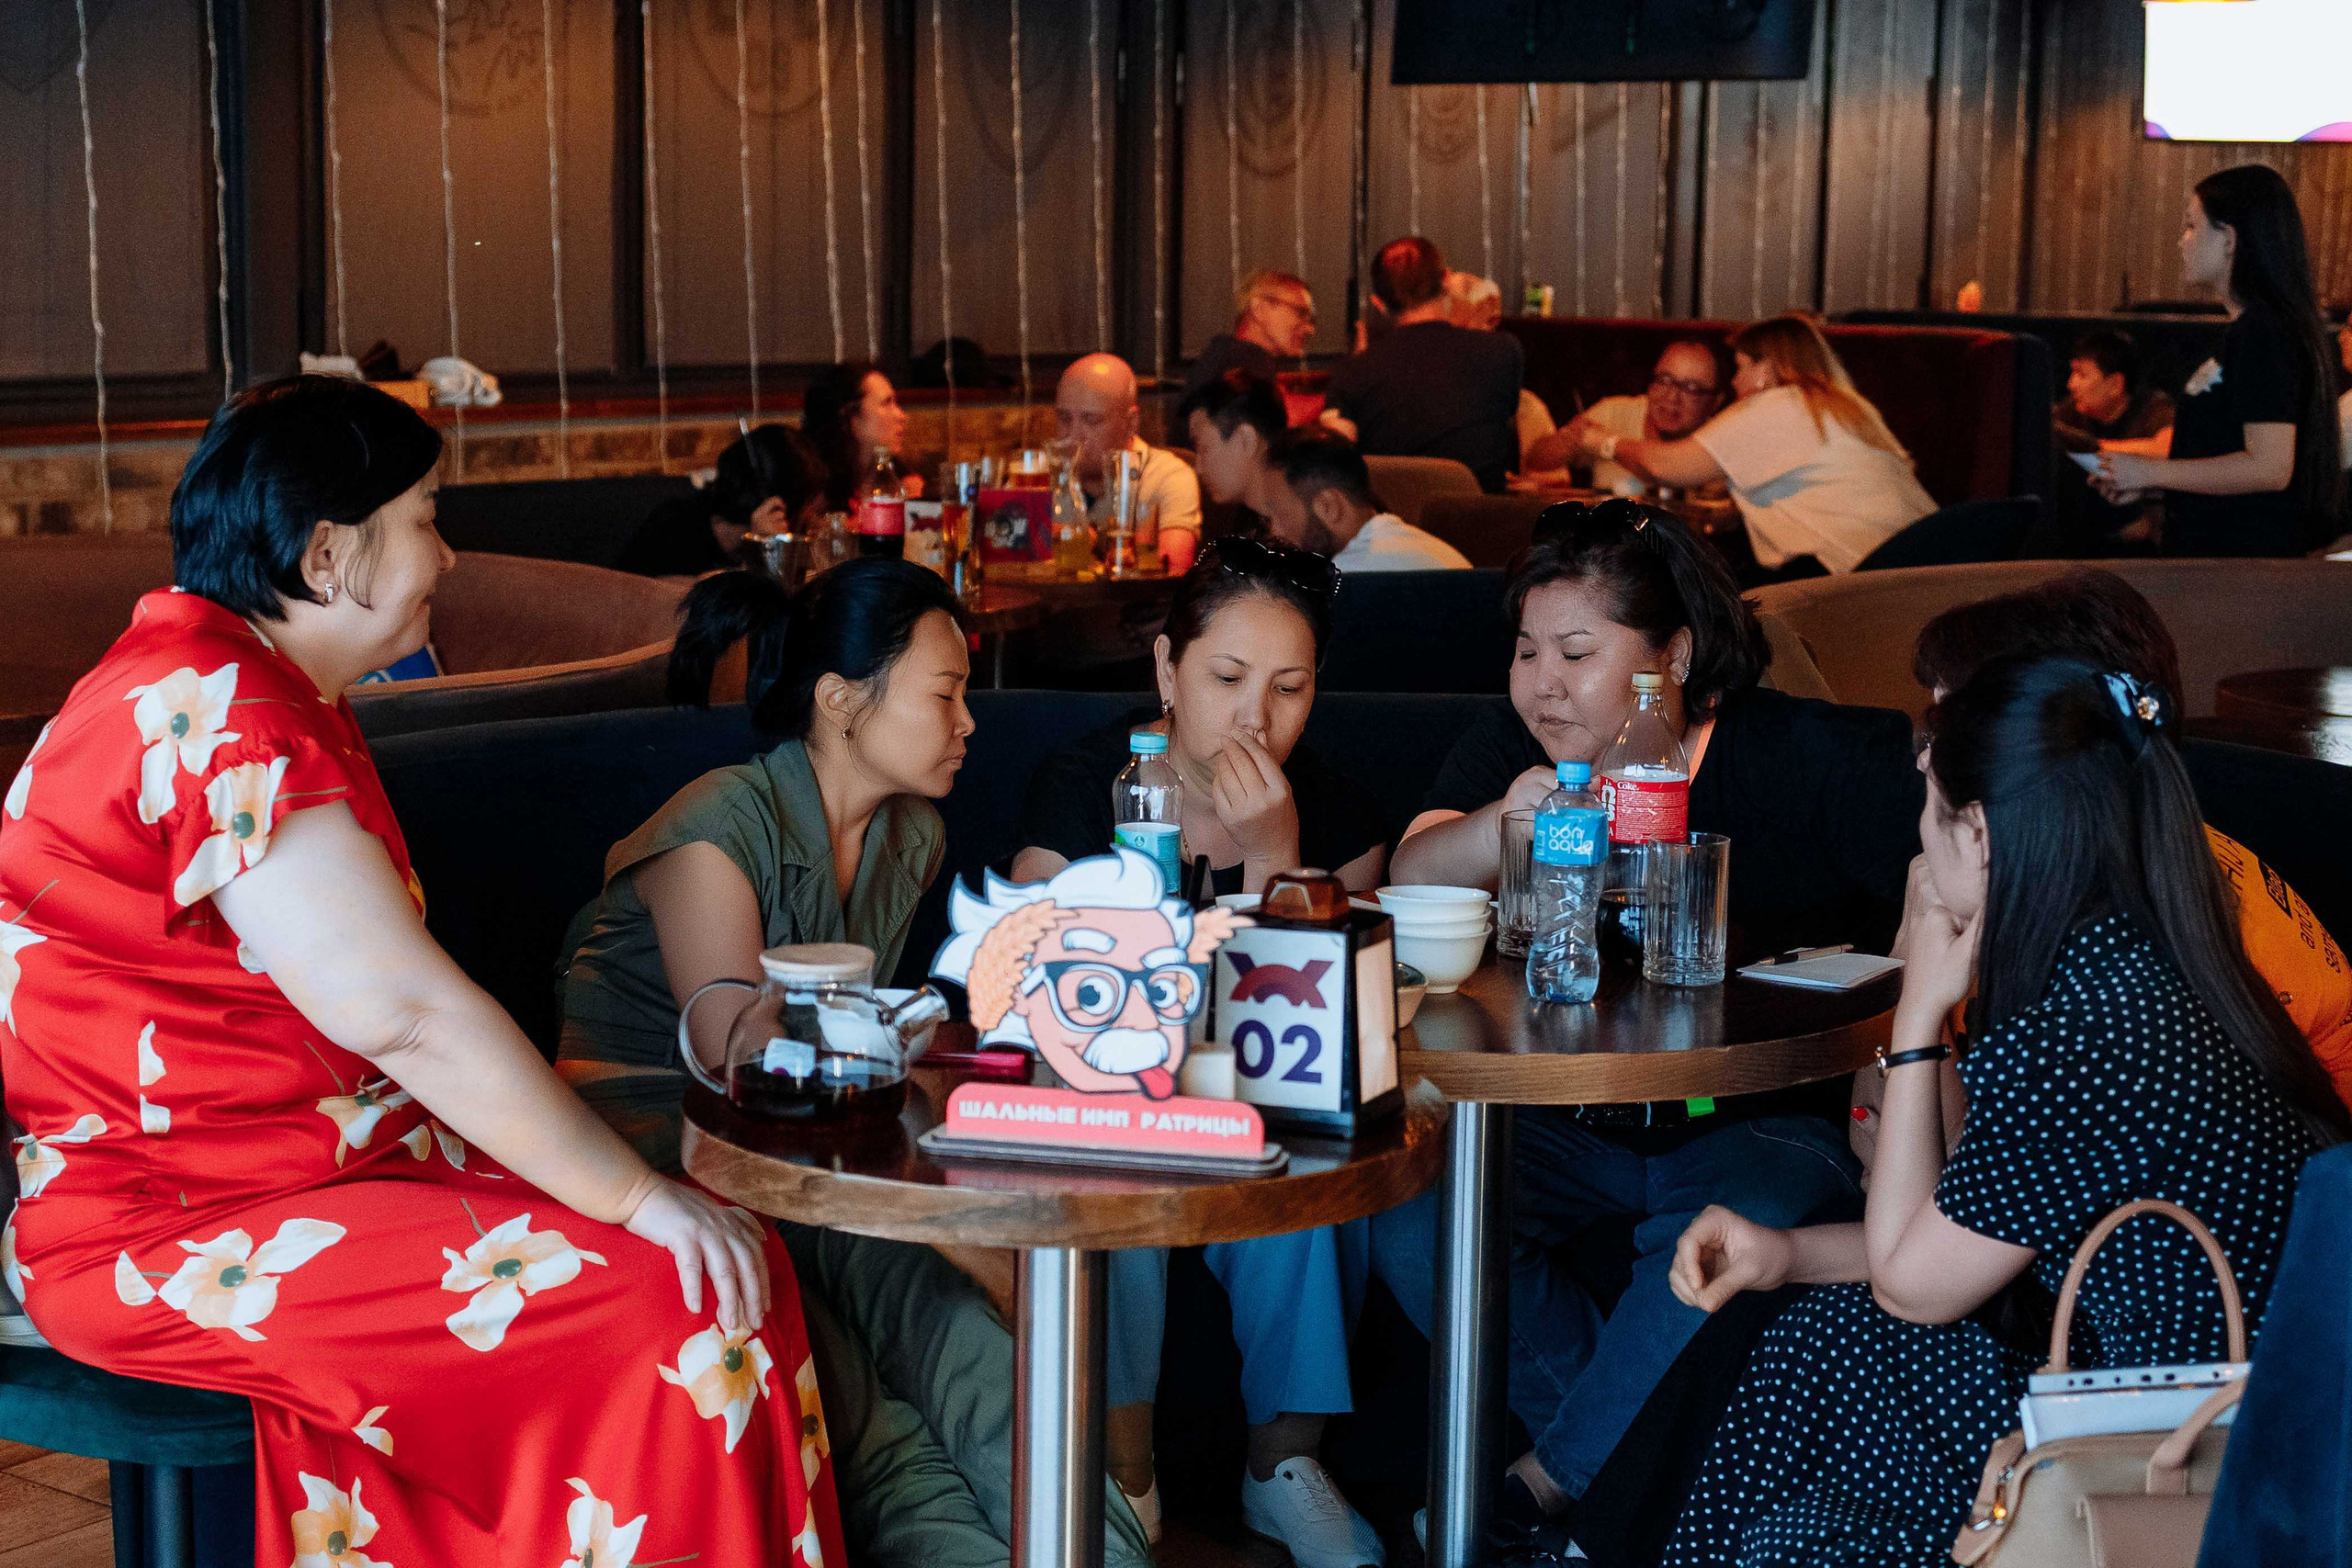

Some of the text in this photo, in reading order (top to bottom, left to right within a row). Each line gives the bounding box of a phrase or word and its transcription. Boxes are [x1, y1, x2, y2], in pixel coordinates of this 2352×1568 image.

[1549, 838, 1594, 854] aqua
[2293, 908, 2315, 949] and
[1232, 1020, 1322, 1084] 02
[959, 1100, 1077, 1124] ШАЛЬНЫЕ
[1140, 1111, 1251, 1137] РАТРИЦЫ
